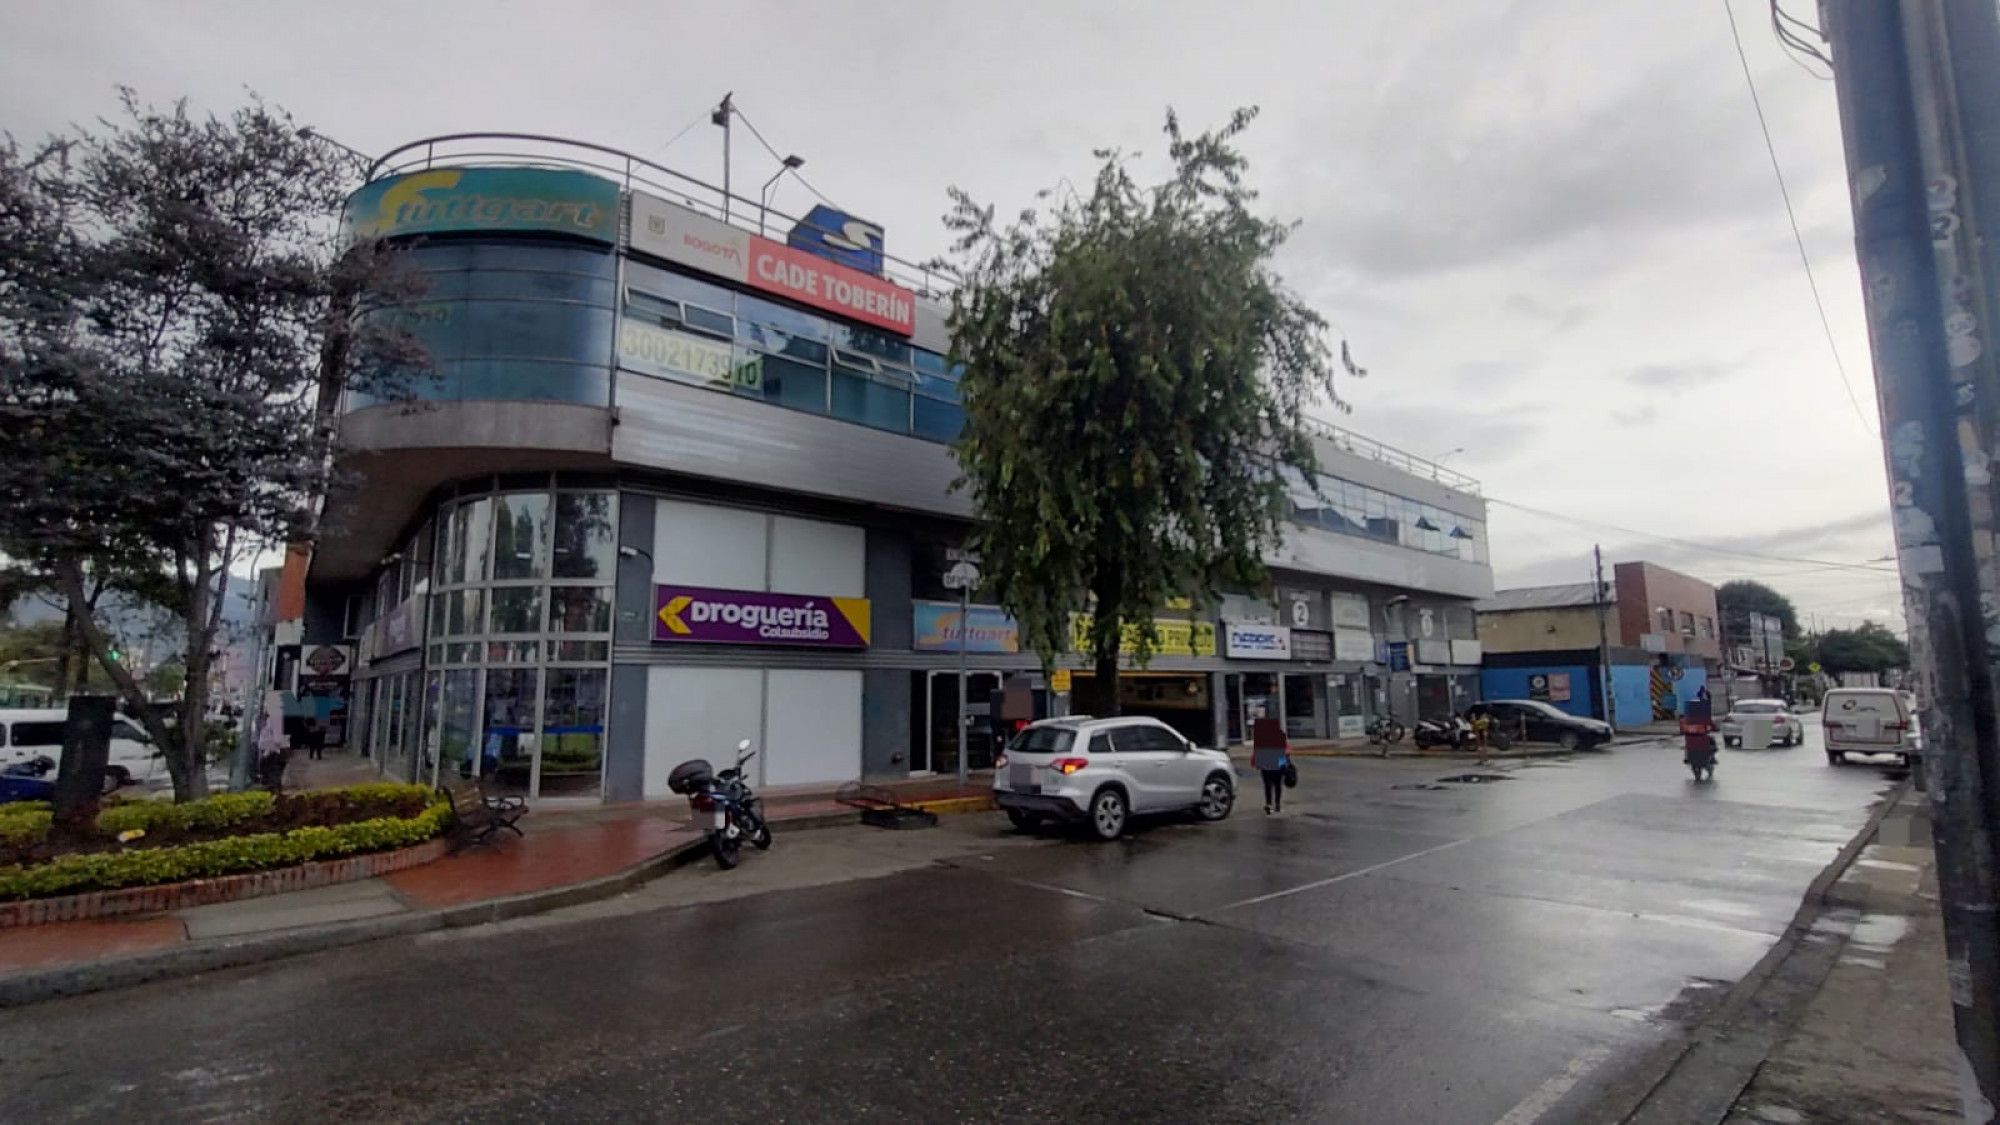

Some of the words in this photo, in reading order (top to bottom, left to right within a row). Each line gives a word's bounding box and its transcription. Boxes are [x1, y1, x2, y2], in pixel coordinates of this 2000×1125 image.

[756, 254, 819, 296] CADE
[822, 274, 910, 325] TOBERÍN
[690, 600, 830, 629] Droguería
